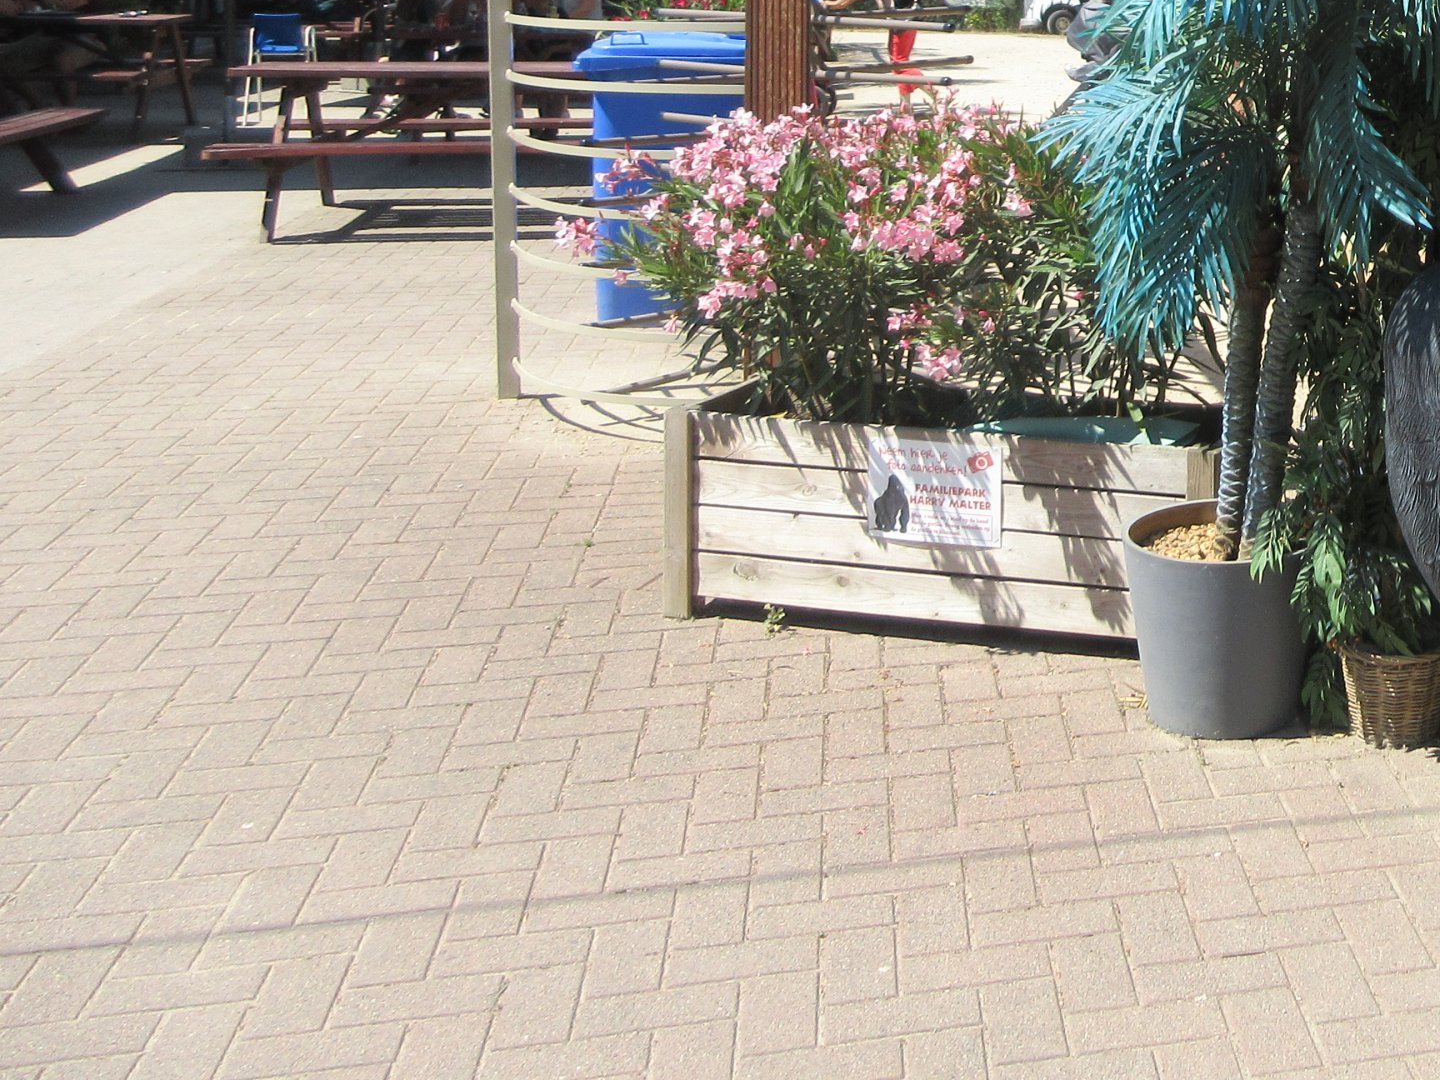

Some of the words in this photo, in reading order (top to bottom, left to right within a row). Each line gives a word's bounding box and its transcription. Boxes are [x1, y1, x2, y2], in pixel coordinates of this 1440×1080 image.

[886, 459, 906, 471] foto
[915, 483, 986, 498] FAMILIEPARK
[909, 495, 945, 506] HARRY
[949, 499, 992, 511] MALTER
